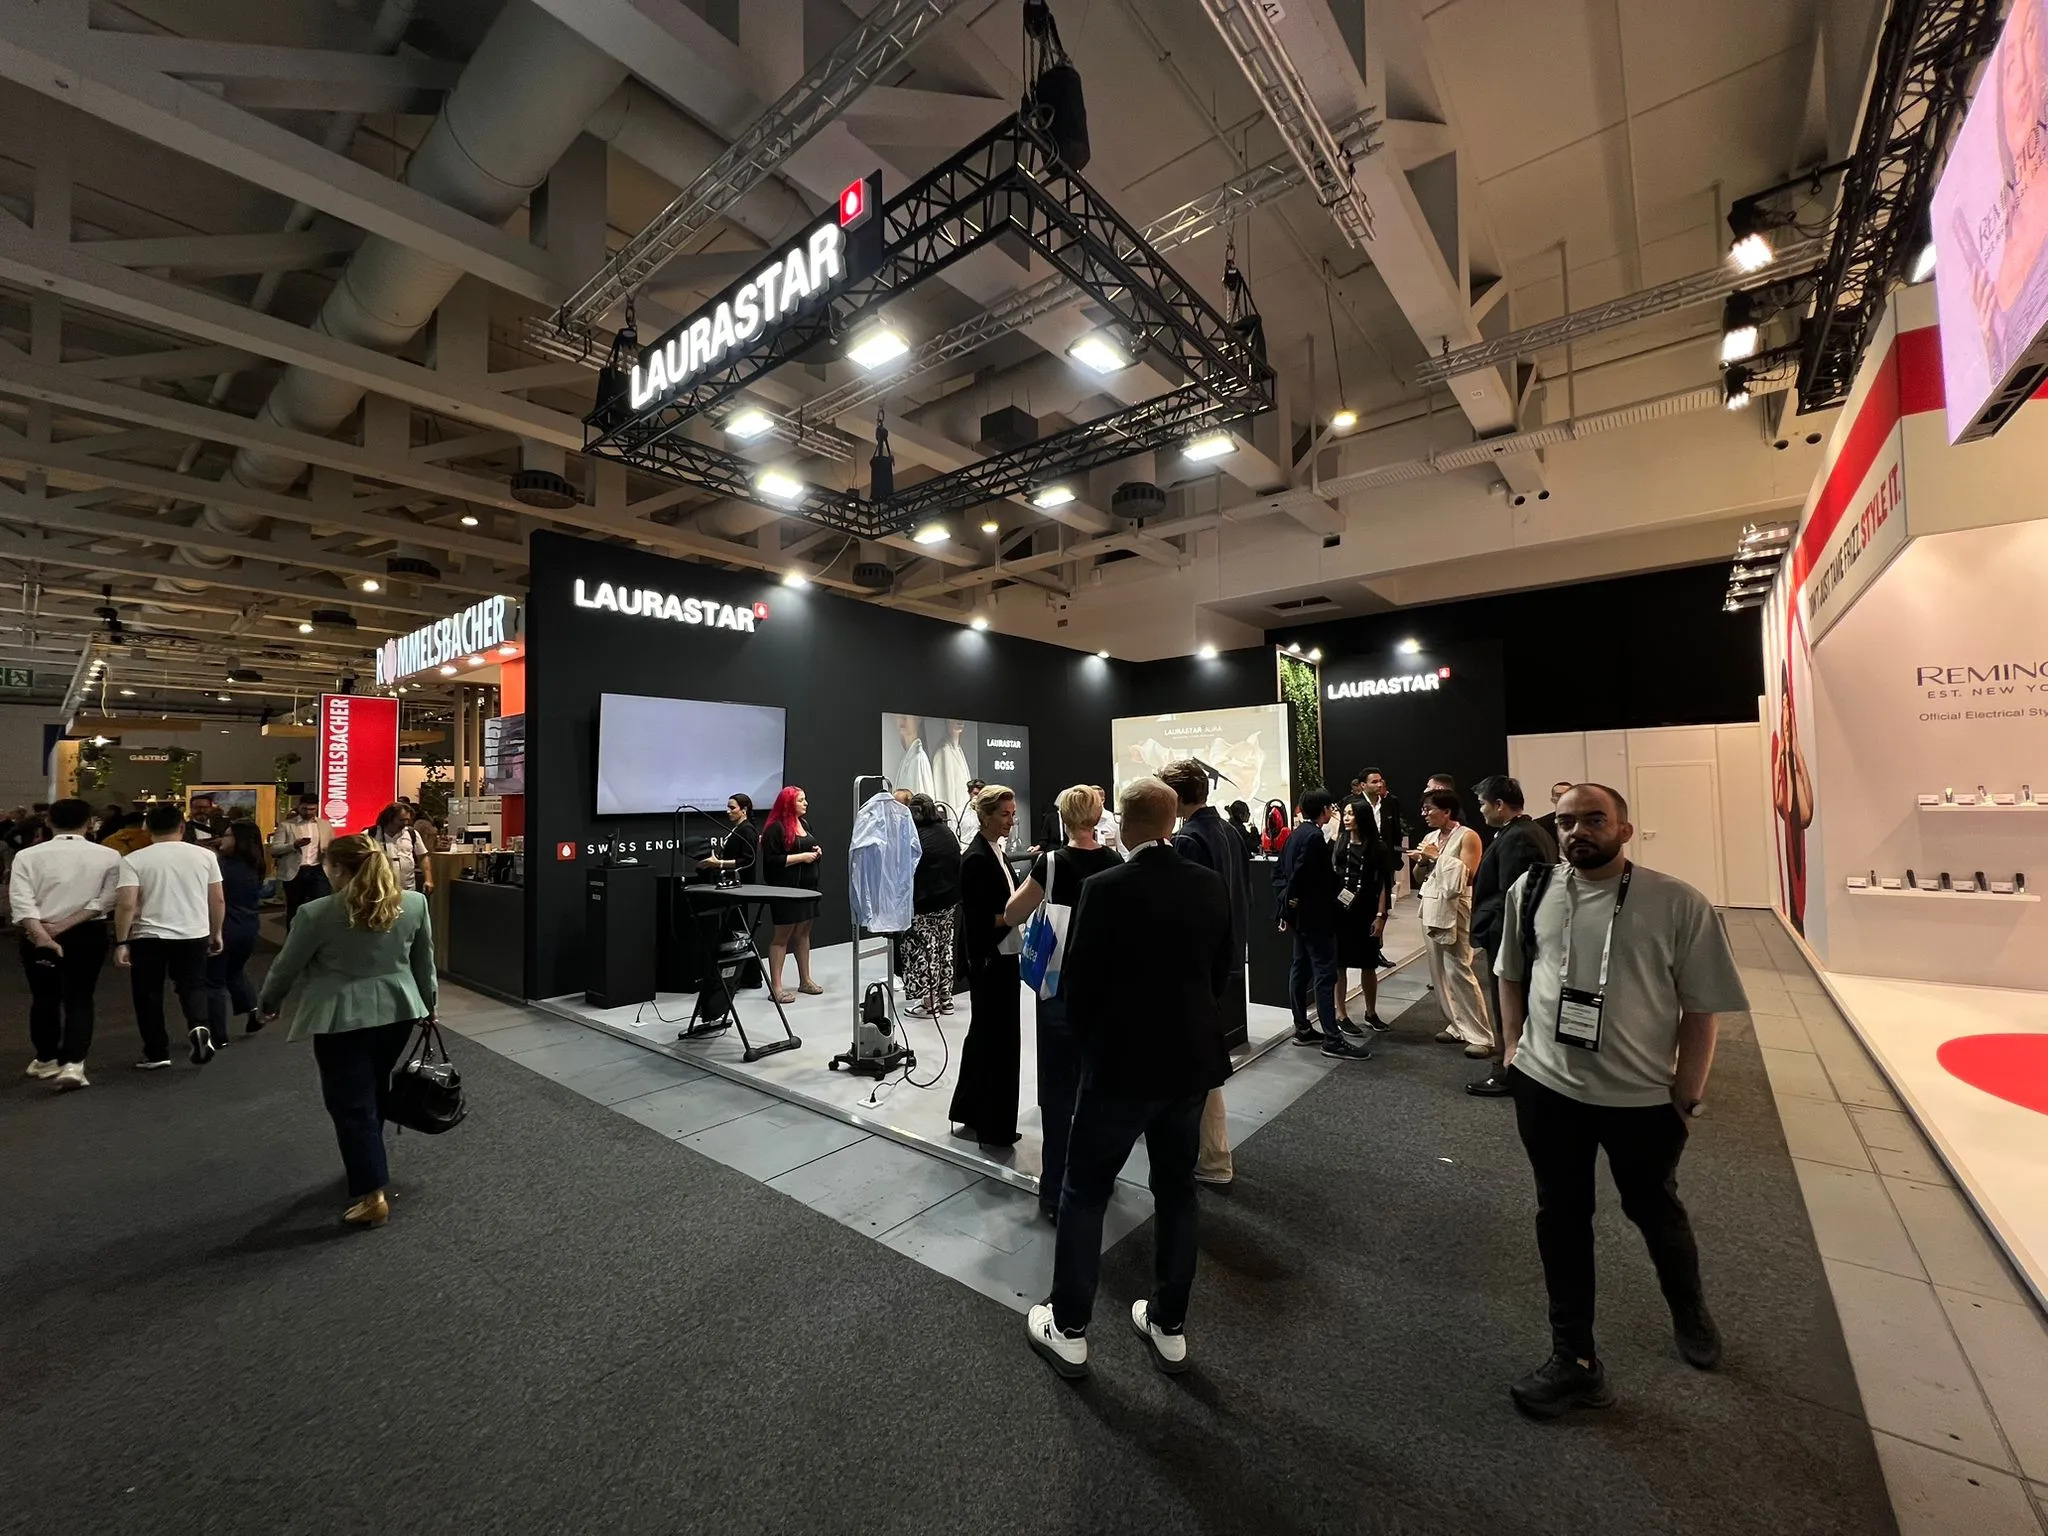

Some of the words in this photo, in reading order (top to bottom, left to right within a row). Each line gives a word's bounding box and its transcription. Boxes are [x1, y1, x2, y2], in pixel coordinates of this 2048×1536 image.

[631, 222, 843, 410] LAURASTAR
[1860, 479, 1888, 549] STYLE
[1888, 462, 1902, 511] IT.
[574, 578, 755, 633] LAURASTAR
[376, 594, 505, 686] ROMMELSBACHER
[1327, 673, 1440, 700] LAURASTAR
[1927, 689, 1962, 699] EST.
[1972, 686, 2014, 697] NEW
[1919, 712, 1961, 721] Official
[1965, 709, 2024, 719] Electrical
[986, 738, 1022, 749] LAURASTAR
[324, 699, 349, 828] ROMMELSBACHER
[994, 760, 1015, 771] BOSS
[586, 841, 637, 855] SWSS
